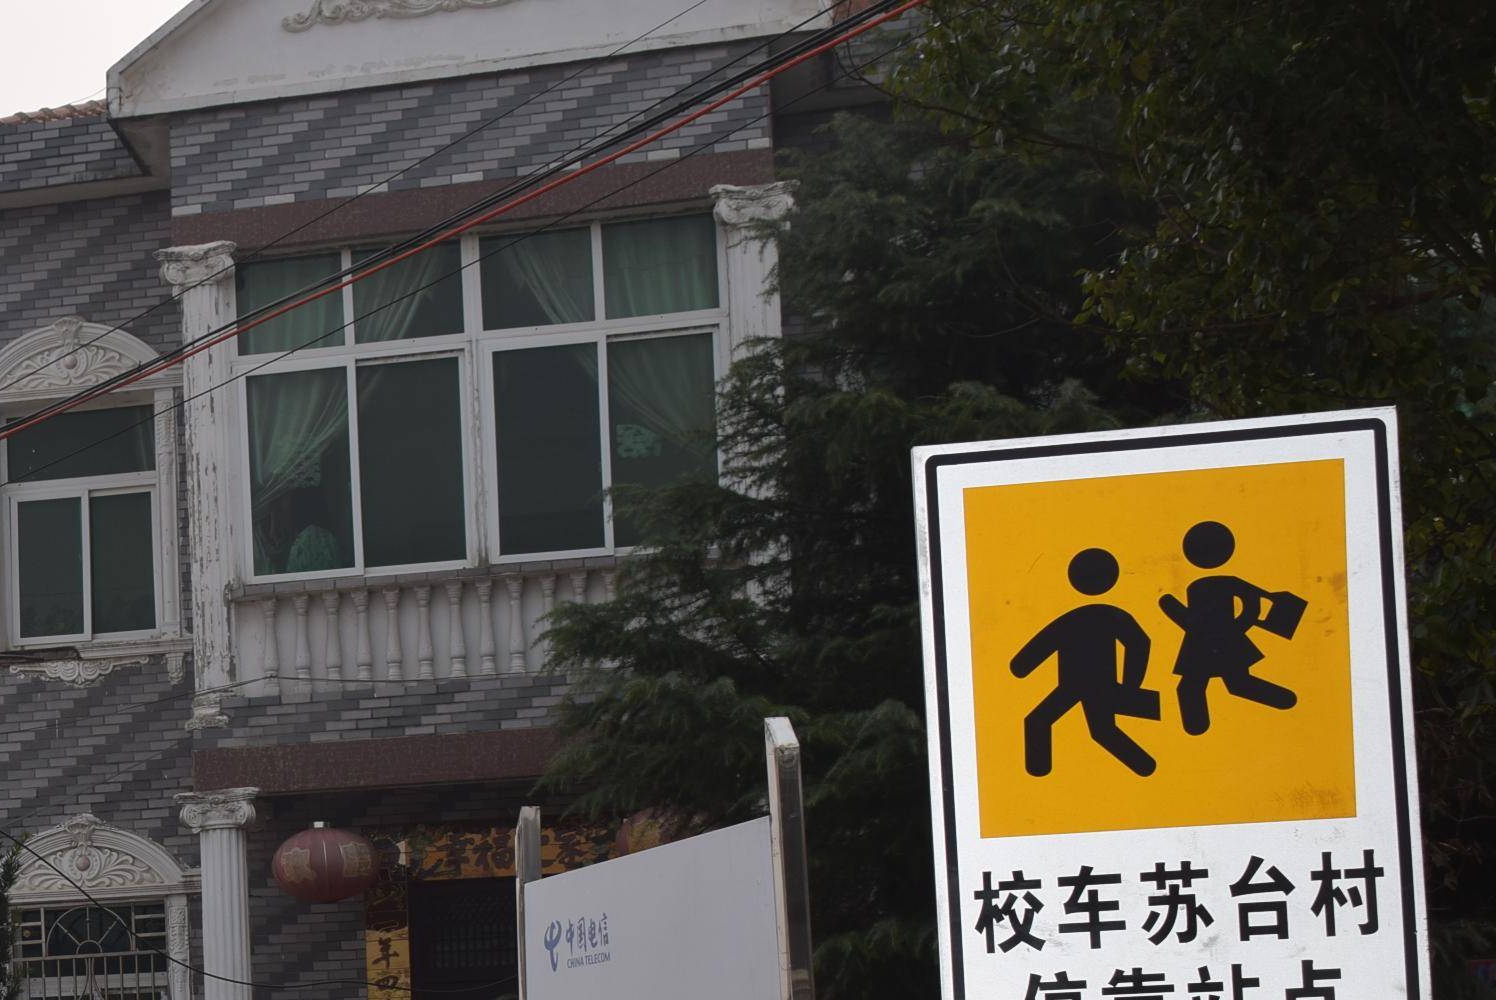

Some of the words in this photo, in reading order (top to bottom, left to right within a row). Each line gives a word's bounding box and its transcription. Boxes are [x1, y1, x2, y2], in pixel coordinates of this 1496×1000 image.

[975, 849, 1384, 953] 校车苏台村
[566, 912, 608, 957] 中国电信
[567, 957, 584, 969] CHINA
[585, 952, 611, 966] TELECOM
